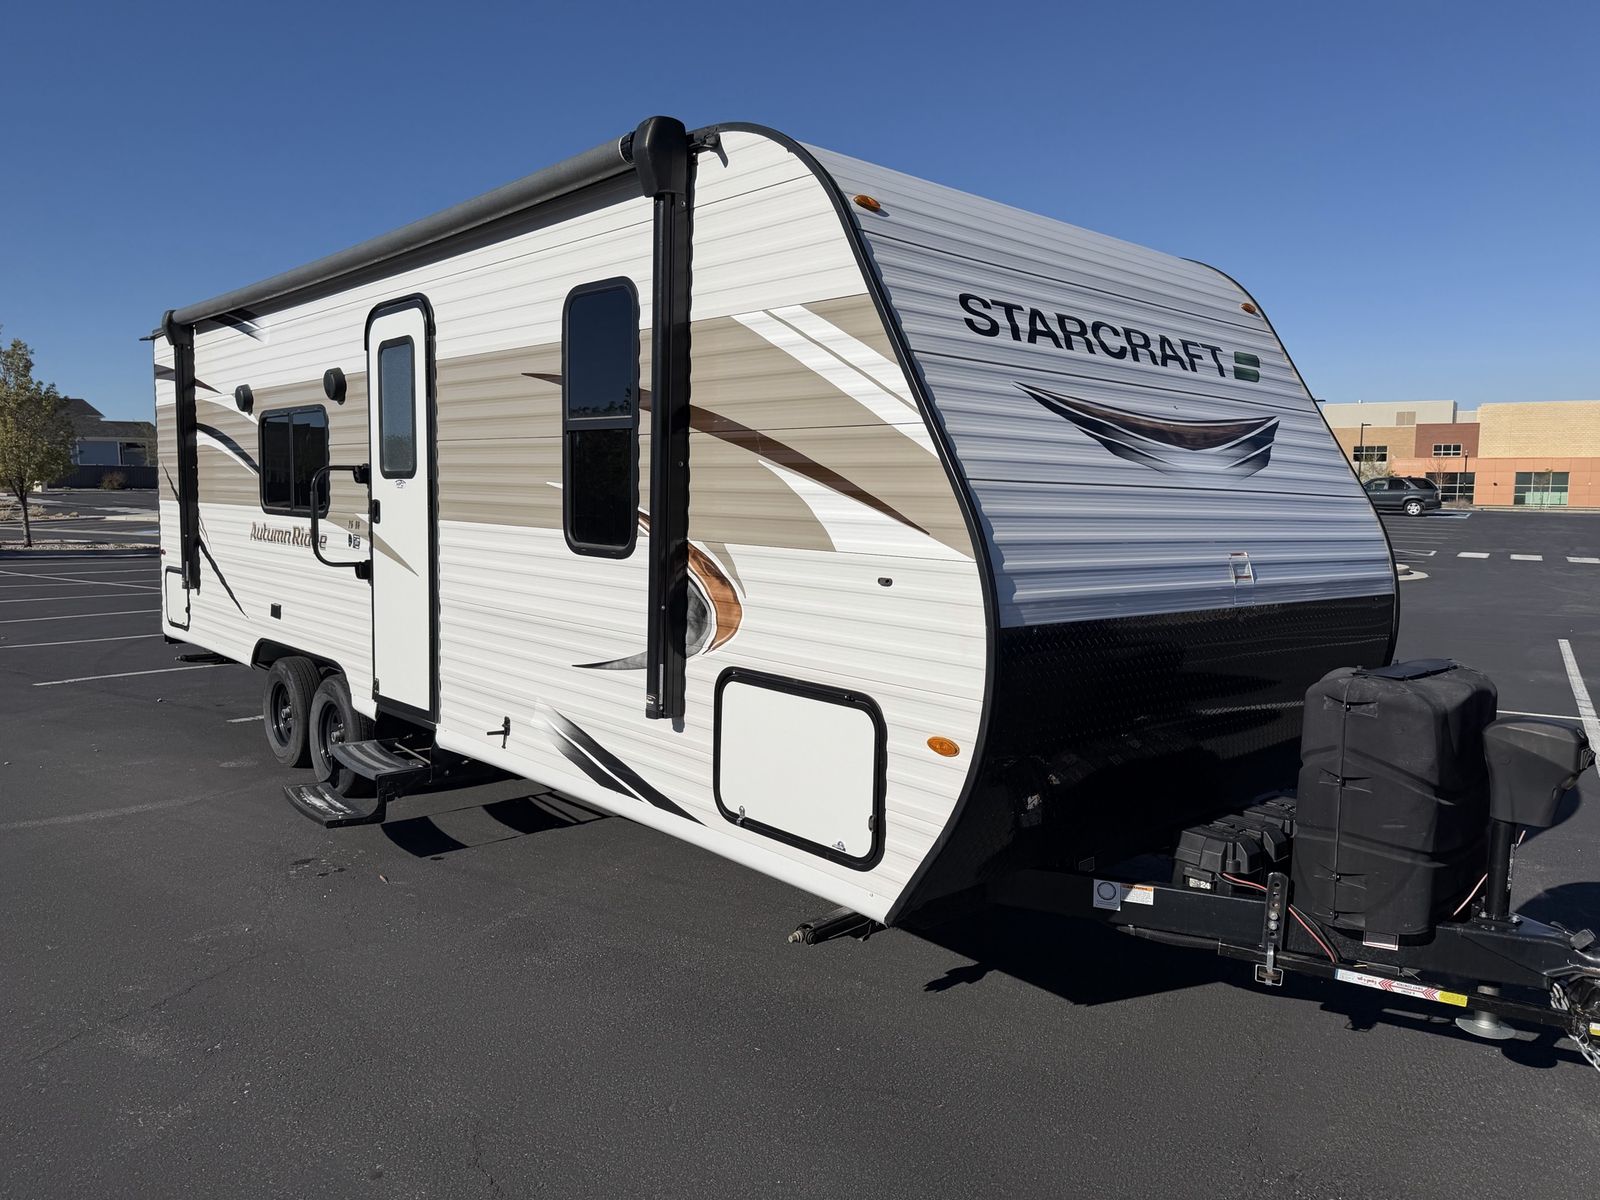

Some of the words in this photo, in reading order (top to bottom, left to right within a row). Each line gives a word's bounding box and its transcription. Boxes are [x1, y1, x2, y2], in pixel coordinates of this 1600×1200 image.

[958, 292, 1226, 378] STARCRAFT
[250, 522, 292, 543] Autumn
[292, 526, 327, 550] Ride
